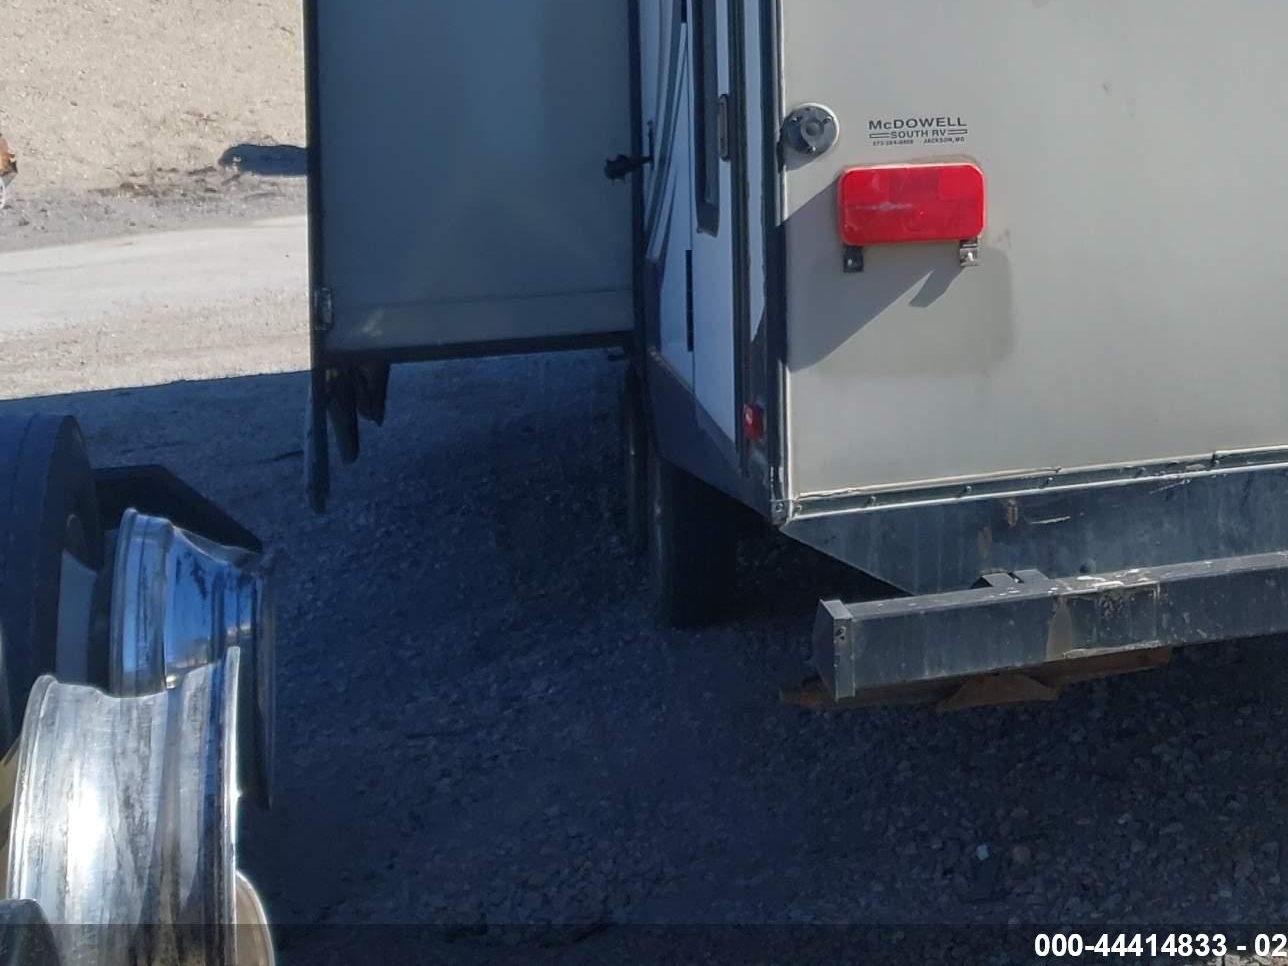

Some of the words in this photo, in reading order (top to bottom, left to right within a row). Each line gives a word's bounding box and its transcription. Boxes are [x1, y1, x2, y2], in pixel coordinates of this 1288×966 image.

[868, 117, 967, 130] McDOWELL
[891, 130, 929, 139] SOUTH
[931, 128, 947, 137] RV
